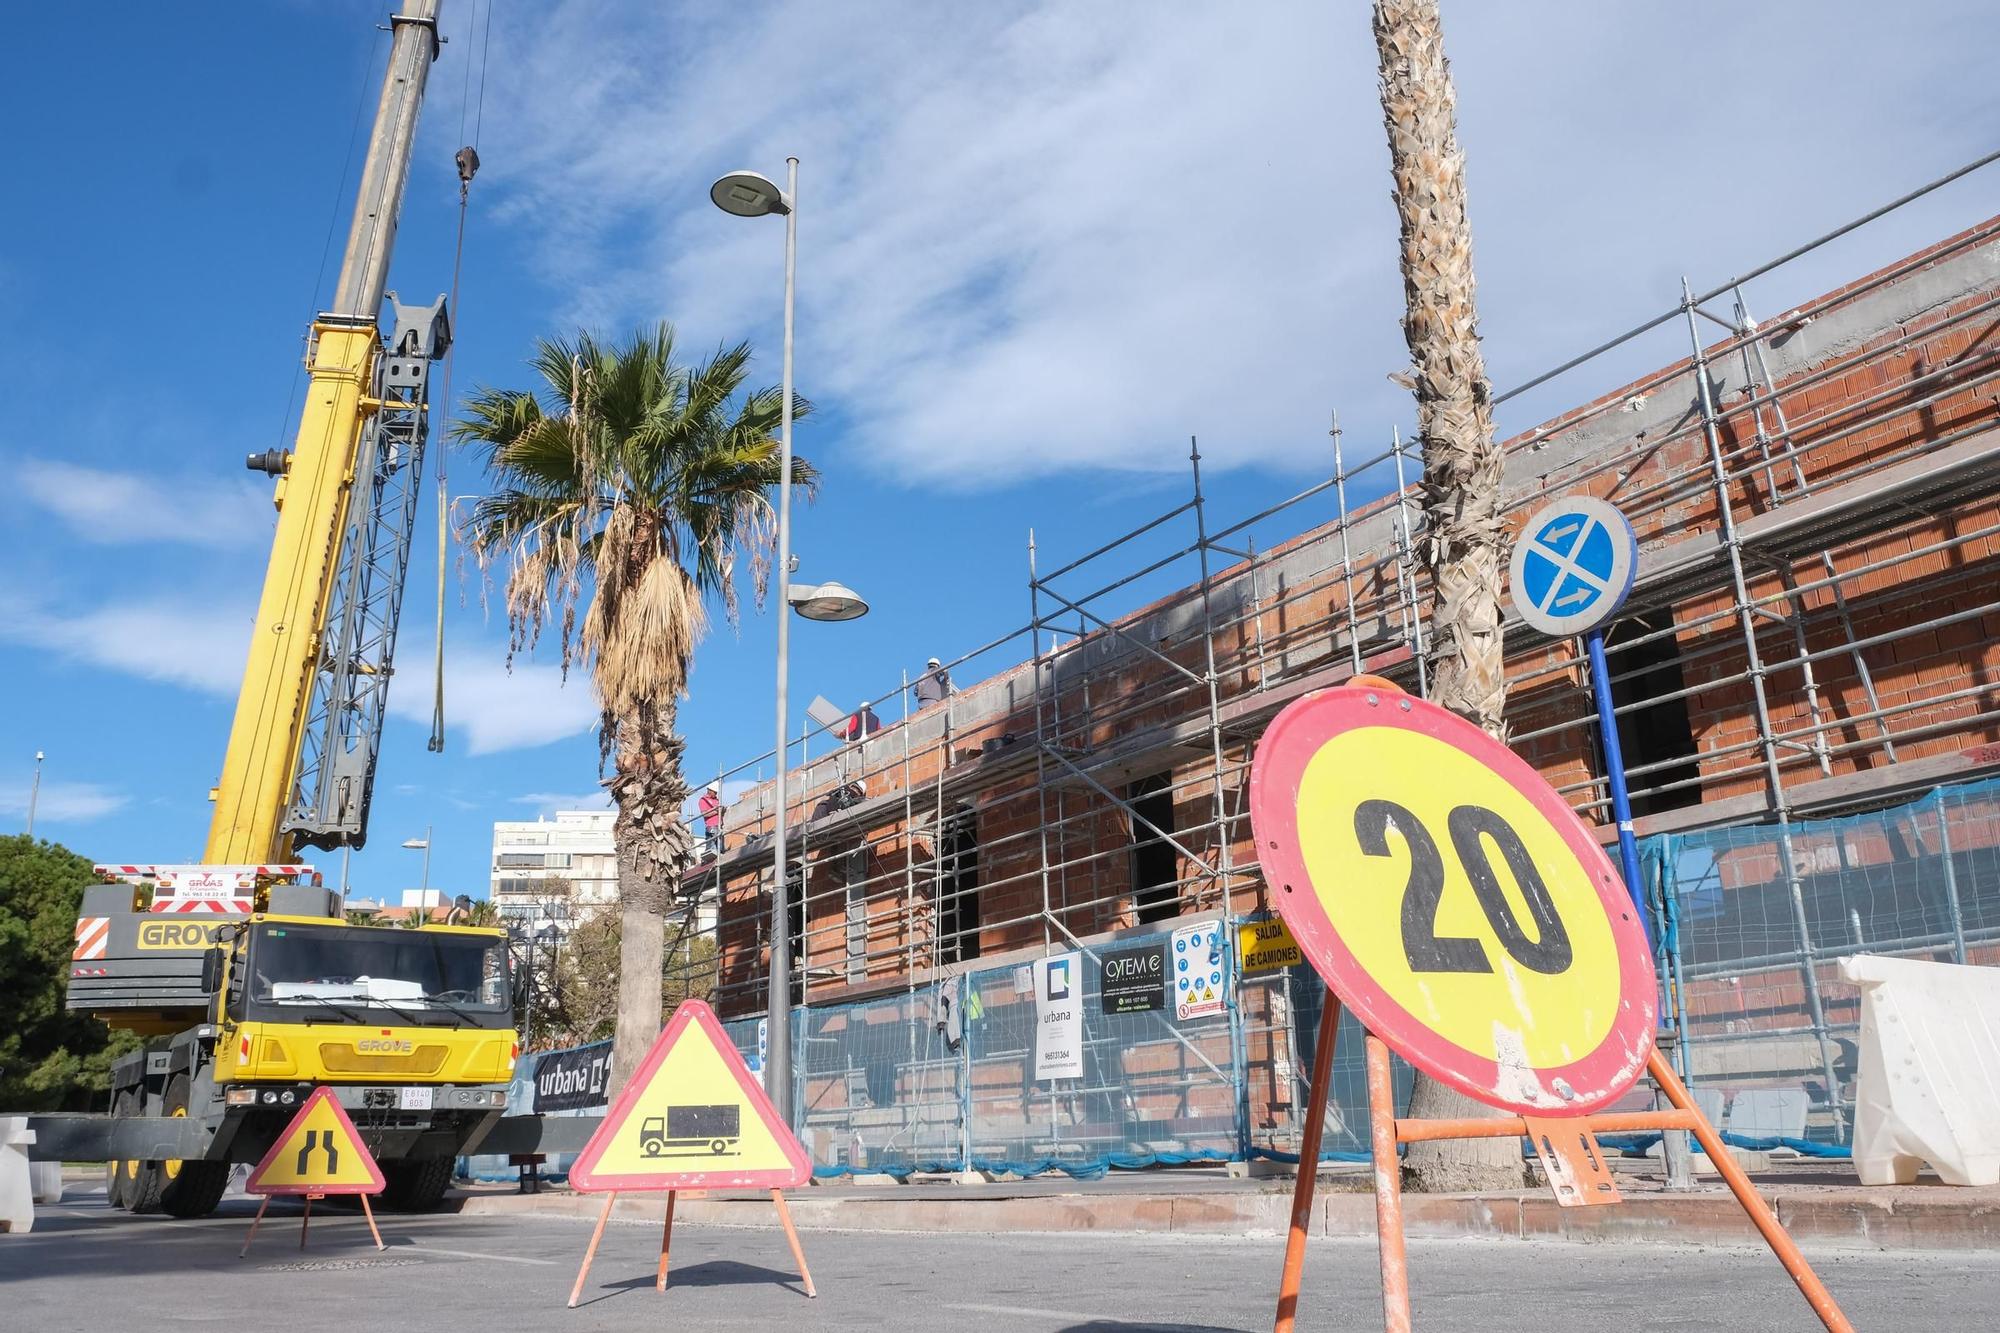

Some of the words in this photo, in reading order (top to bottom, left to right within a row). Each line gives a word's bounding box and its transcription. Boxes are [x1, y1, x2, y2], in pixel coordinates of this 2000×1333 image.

[188, 878, 223, 887] GRUAS
[1354, 799, 1573, 975] 20
[1255, 924, 1282, 941] SALIDA
[1245, 953, 1255, 967] DE
[1257, 946, 1298, 966] CAMIONES
[1043, 1010, 1071, 1024] urbana
[358, 1040, 412, 1052] GROVE
[540, 1063, 588, 1096] urbana
